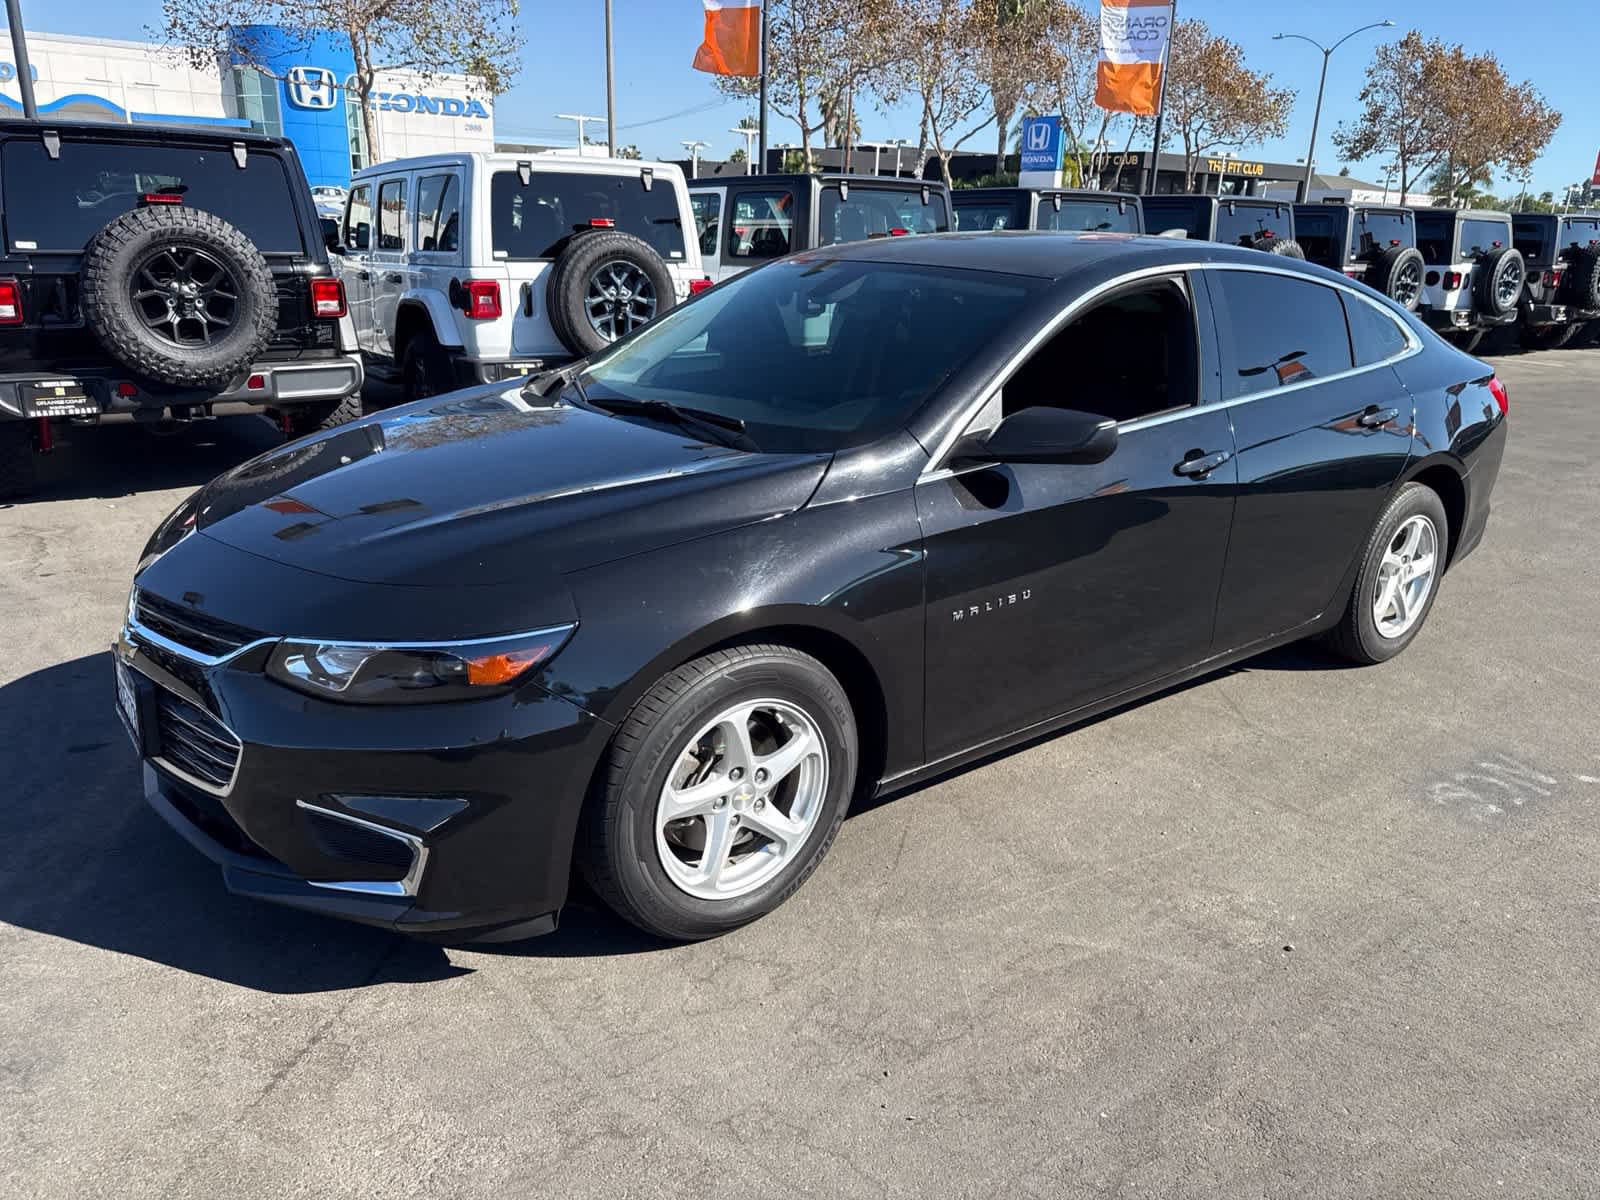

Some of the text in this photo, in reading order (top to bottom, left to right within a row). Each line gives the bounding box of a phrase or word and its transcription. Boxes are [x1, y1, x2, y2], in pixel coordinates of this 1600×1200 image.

[1208, 160, 1264, 175] THE FIT CLUB
[952, 589, 1032, 621] MALIBU
